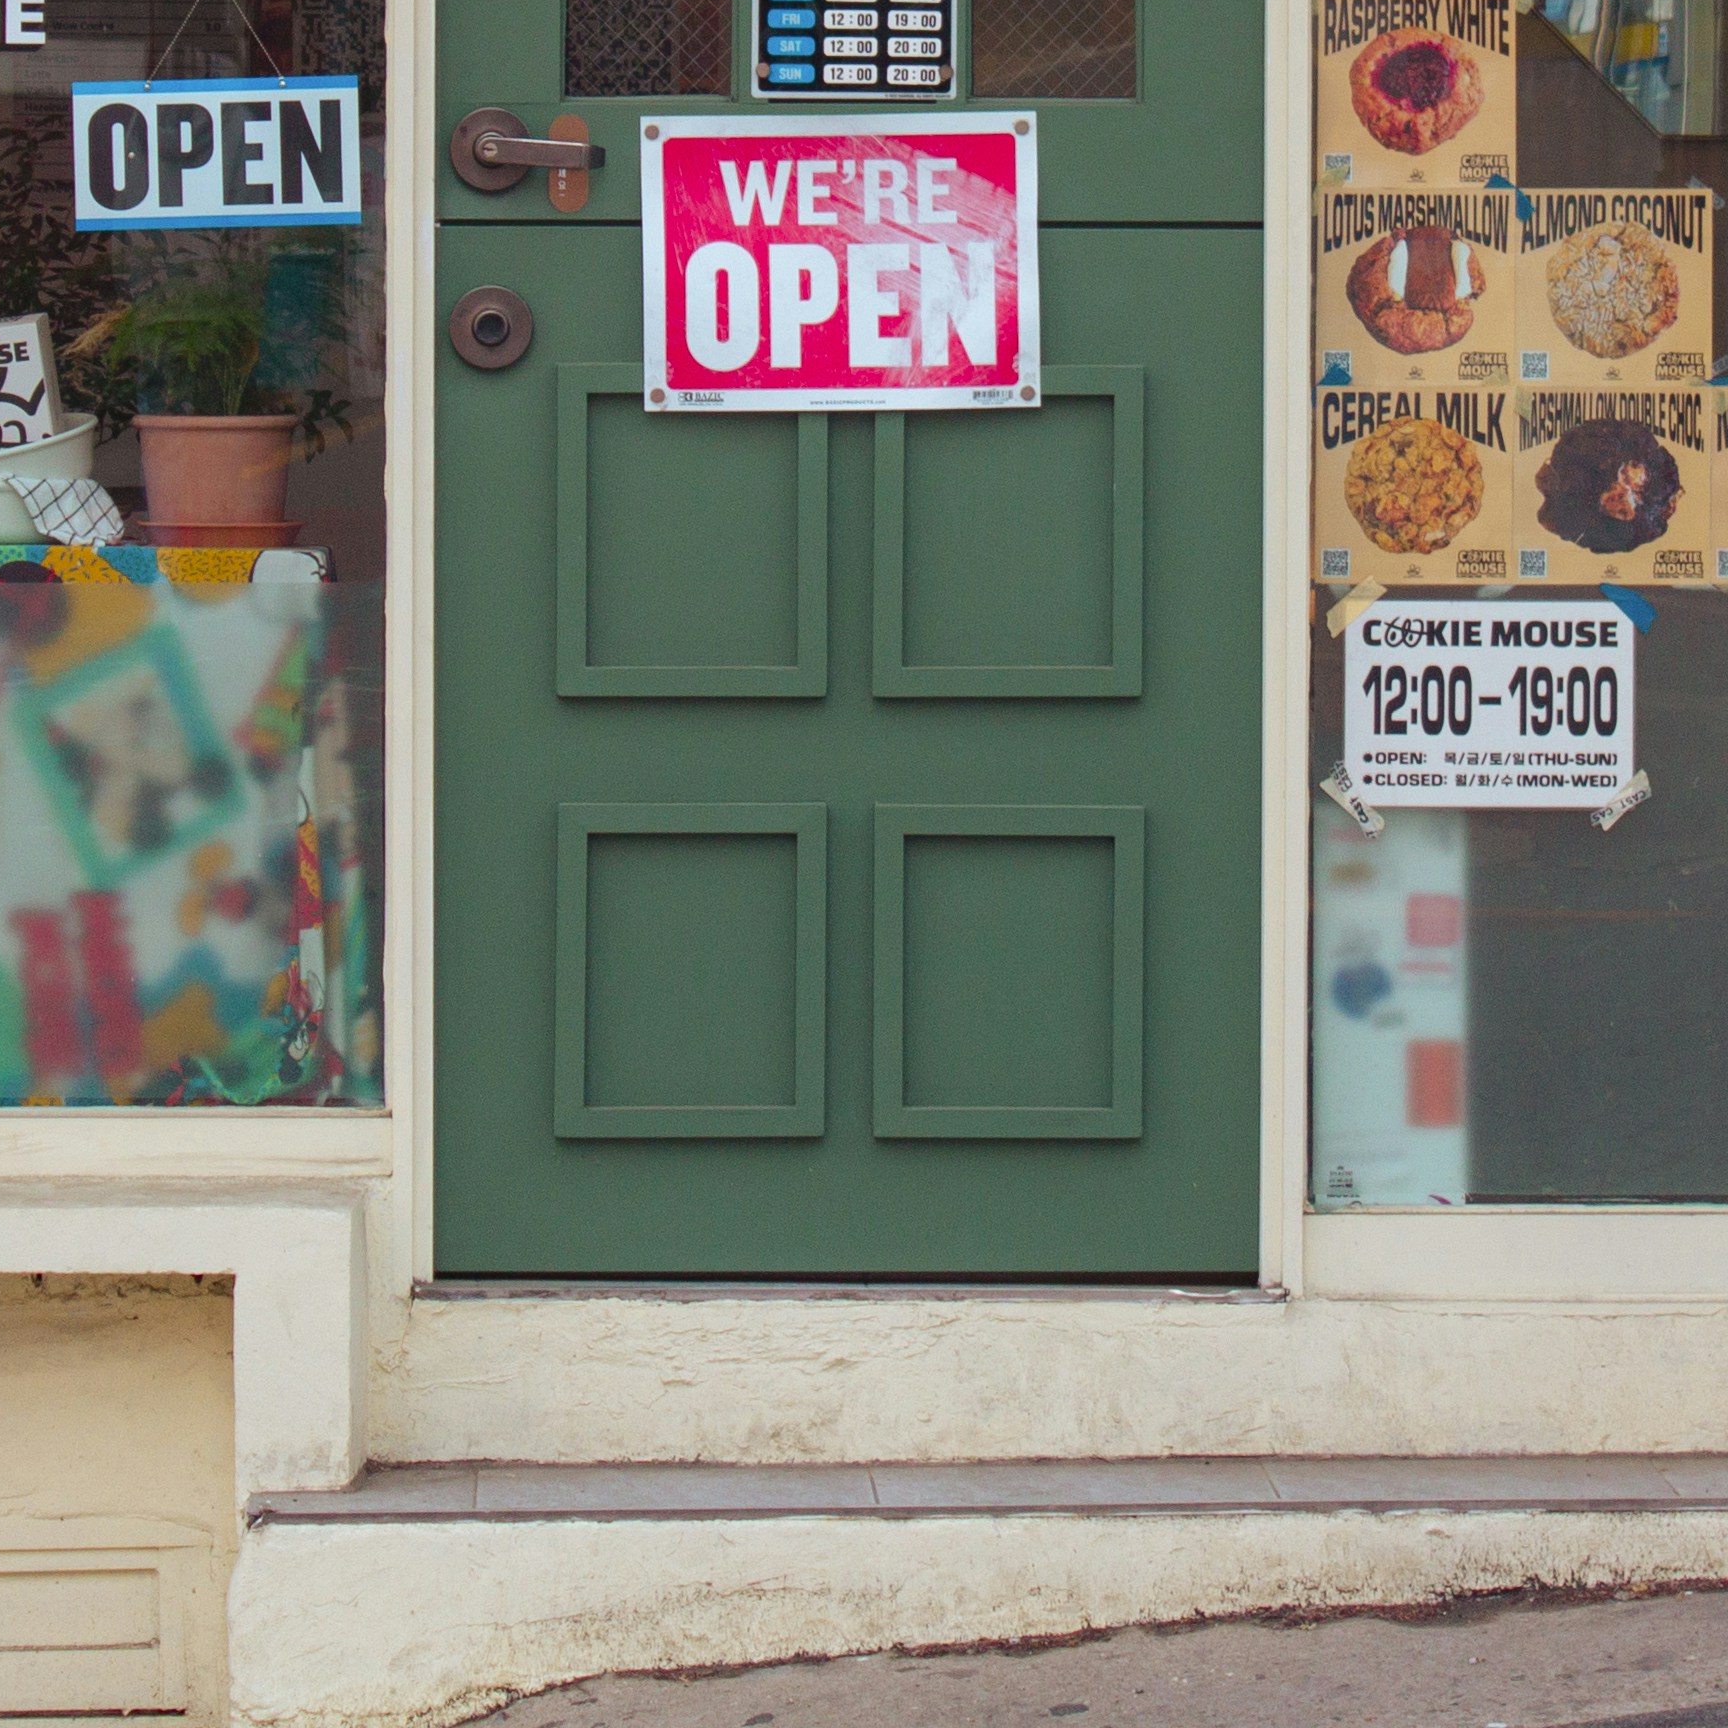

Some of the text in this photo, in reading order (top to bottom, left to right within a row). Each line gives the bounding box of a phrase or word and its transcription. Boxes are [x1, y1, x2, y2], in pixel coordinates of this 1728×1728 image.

[782, 13, 801, 25] FRI
[779, 41, 801, 52] SAT
[779, 68, 802, 80] SUN
[87, 99, 344, 211] OPEN
[1460, 155, 1508, 168] COOKIE
[719, 158, 958, 226] WE'RE
[1324, 194, 1509, 253] LOTUS MARSHMALLOW
[1521, 195, 1706, 254] ALMOND COCONUT
[685, 238, 998, 372] OPEN
[1460, 352, 1507, 366] COOKIE
[1656, 352, 1704, 366] COOKIE
[1655, 365, 1705, 378] MOUSE
[694, 392, 725, 402] BAZIC
[1323, 392, 1506, 452] CEREAL MILK
[1520, 392, 1616, 452] MARSHMALLOW
[1620, 393, 1666, 438] DOUBLE
[1457, 551, 1504, 564] COOKIE
[1654, 551, 1701, 564] COOKIE
[1457, 562, 1505, 576] MOUSE
[1653, 562, 1704, 576] MOUSE
[1363, 616, 1618, 649] COOKIE MOUSE
[1375, 752, 1427, 765] OPEN:
[1375, 773, 1448, 787] CLOSED:
[1620, 790, 1646, 809] CAST
[1350, 796, 1369, 823] CAST
